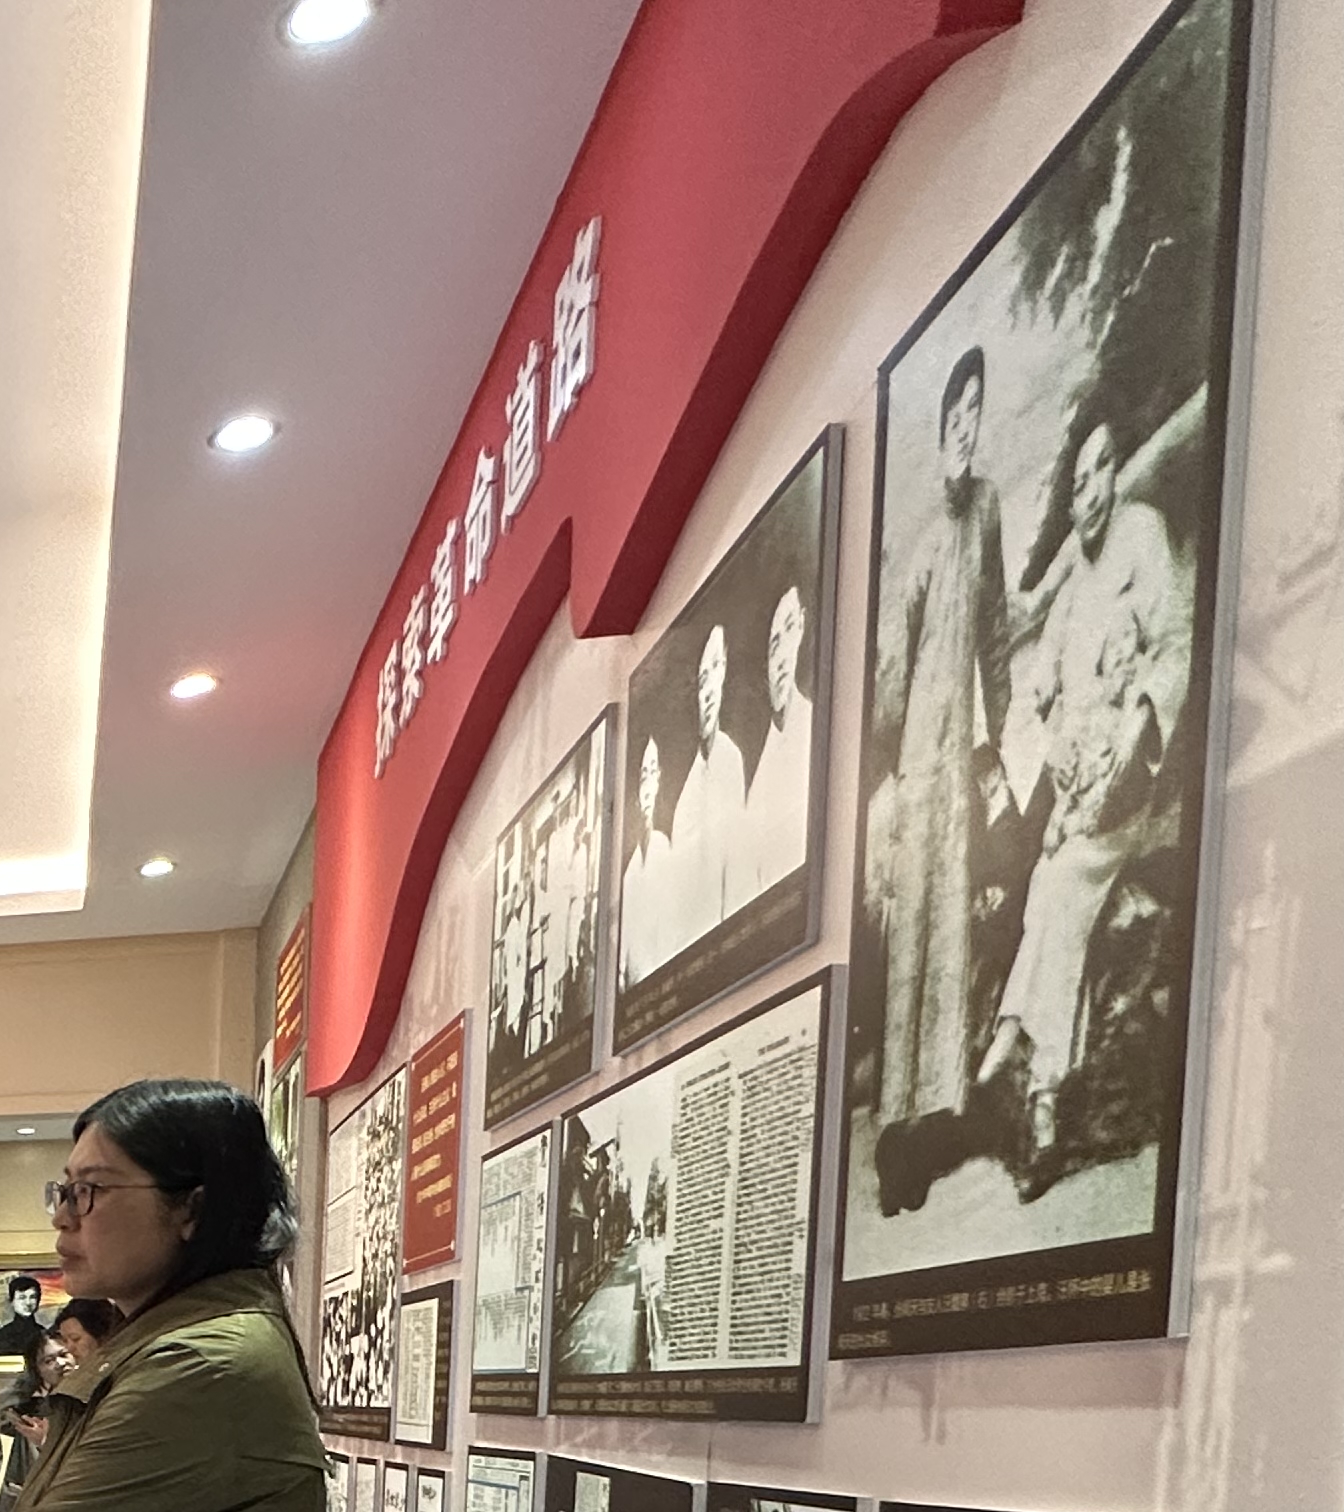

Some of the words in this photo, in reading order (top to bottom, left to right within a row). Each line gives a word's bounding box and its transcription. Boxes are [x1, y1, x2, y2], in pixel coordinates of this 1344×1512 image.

[375, 216, 602, 779] 探索革命道路
